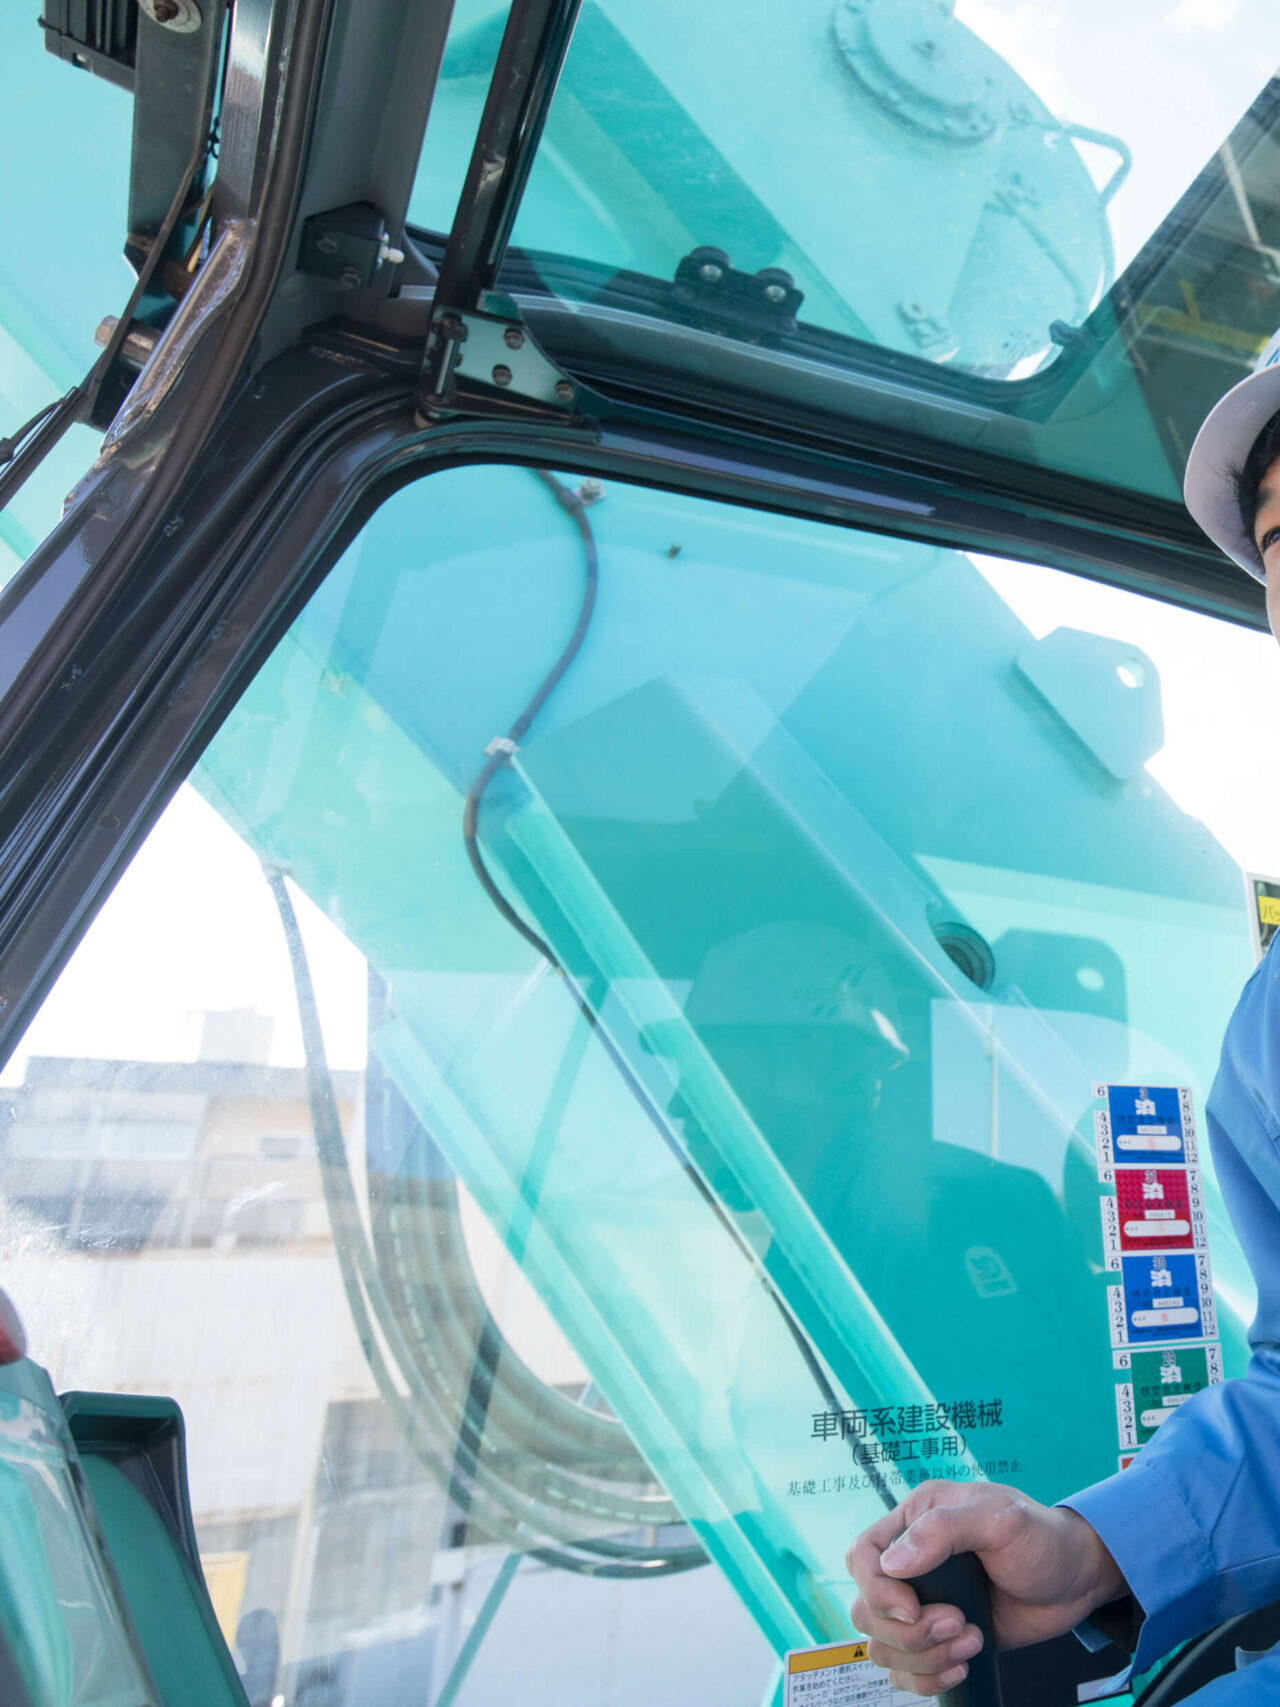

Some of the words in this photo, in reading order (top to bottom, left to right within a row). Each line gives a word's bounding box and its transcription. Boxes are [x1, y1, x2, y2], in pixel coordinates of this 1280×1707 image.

[1098, 1087, 1105, 1096] 6
[1181, 1089, 1188, 1099] 7
[1183, 1102, 1189, 1112] 8
[1100, 1112, 1106, 1122] 4
[1184, 1115, 1191, 1124] 9
[1101, 1125, 1108, 1135] 3
[1185, 1128, 1194, 1137] 10
[1102, 1138, 1110, 1148] 2
[1185, 1141, 1195, 1150] 11
[1104, 1152, 1109, 1162] 1
[1186, 1153, 1197, 1162] 12
[1104, 1171, 1112, 1180] 6
[1189, 1171, 1196, 1181] 7
[1191, 1185, 1199, 1194] 8
[1106, 1197, 1113, 1208] 4
[1192, 1198, 1199, 1207] 9
[1108, 1212, 1115, 1222] 3
[1192, 1211, 1203, 1221] 10
[1109, 1225, 1116, 1236] 2
[1194, 1225, 1203, 1234] 11
[1110, 1239, 1116, 1250] 1
[1195, 1238, 1206, 1247] 12
[1111, 1259, 1119, 1269] 6
[1198, 1256, 1205, 1266] 7
[1199, 1270, 1207, 1279] 8
[1113, 1287, 1120, 1298] 4
[1201, 1284, 1208, 1294] 9
[1114, 1302, 1123, 1313] 3
[1201, 1298, 1212, 1307] 10
[1202, 1312, 1212, 1321] 11
[1115, 1316, 1123, 1328] 2
[1204, 1326, 1215, 1335] 12
[1118, 1331, 1123, 1343] 1
[1208, 1348, 1216, 1359] 7
[1120, 1355, 1128, 1366] 6
[1210, 1363, 1219, 1374] 8
[1122, 1385, 1129, 1397] 4
[1123, 1401, 1131, 1412] 3
[811, 1398, 1003, 1442] 車両系建設機械
[1124, 1416, 1133, 1428] 2
[1126, 1432, 1133, 1444] 1
[852, 1434, 968, 1466] （基礎工事用）
